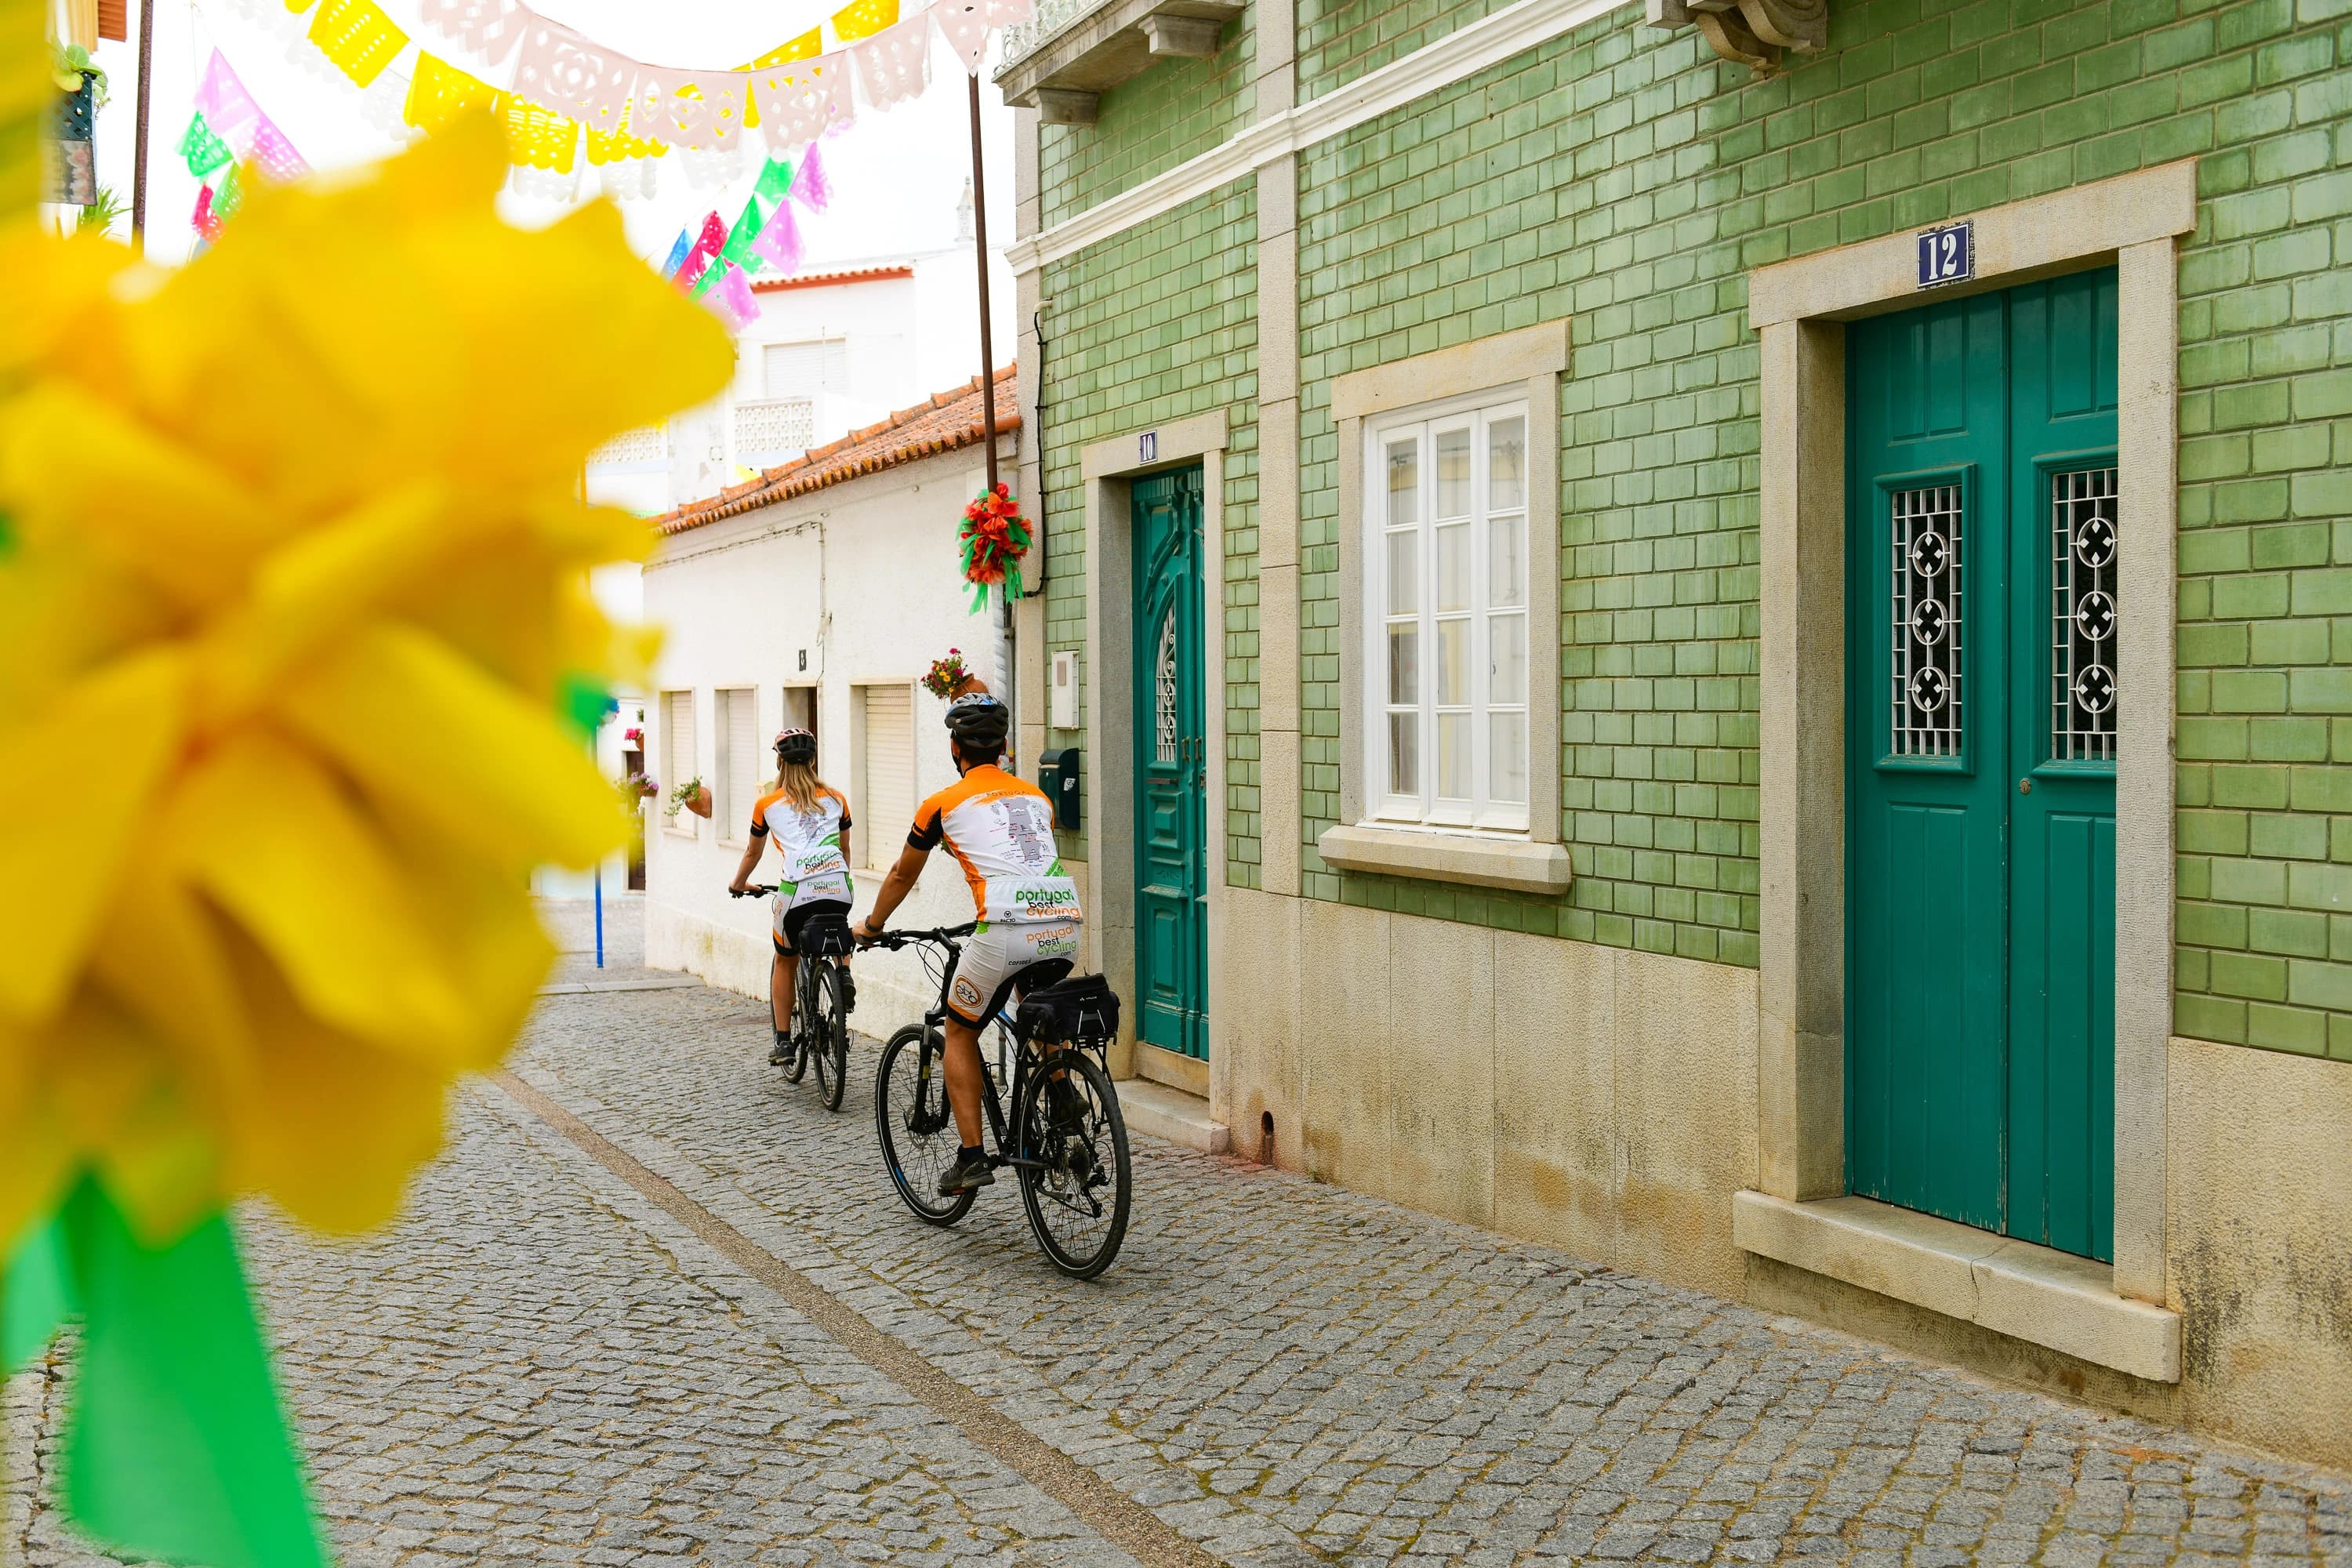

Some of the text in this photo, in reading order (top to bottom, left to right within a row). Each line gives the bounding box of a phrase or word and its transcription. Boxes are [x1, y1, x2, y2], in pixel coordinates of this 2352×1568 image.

[1928, 233, 1958, 281] 12
[1142, 434, 1153, 461] 10
[804, 860, 840, 875] cycling
[1015, 888, 1075, 903] portugal
[1028, 899, 1054, 909] best
[1025, 907, 1080, 920] cycling
[1026, 924, 1075, 943] portugal
[1036, 940, 1076, 956] cycling
[1038, 937, 1059, 947] best
